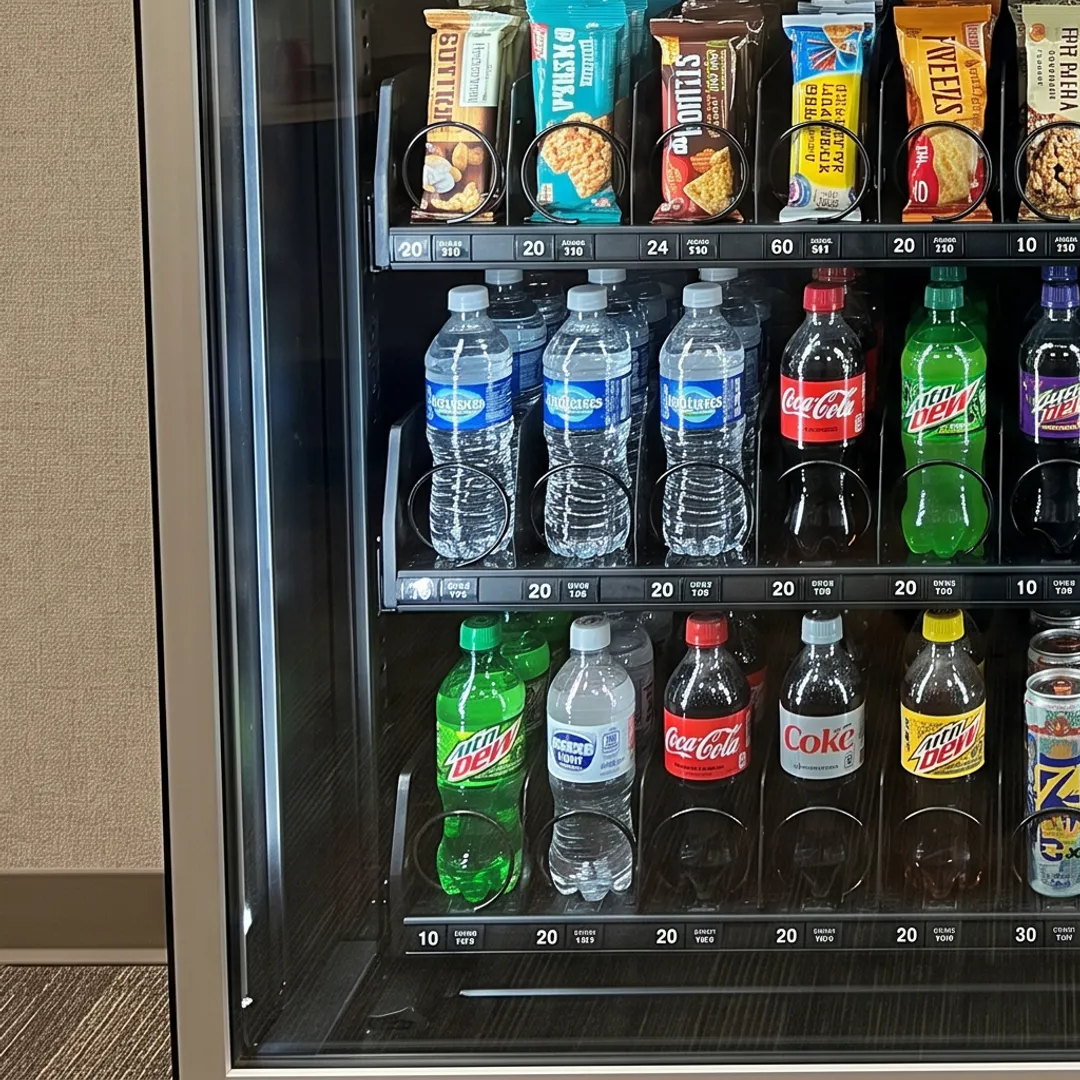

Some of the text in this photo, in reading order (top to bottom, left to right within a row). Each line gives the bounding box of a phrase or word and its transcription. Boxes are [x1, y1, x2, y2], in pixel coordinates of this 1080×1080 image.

[400, 241, 422, 257] 20
[522, 240, 545, 256] 20
[646, 239, 669, 256] 24
[770, 238, 794, 255] 60
[893, 237, 916, 253] 20
[1016, 236, 1038, 253] 10
[528, 582, 552, 599] 20
[651, 582, 674, 598] 20
[771, 581, 795, 597] 20
[894, 580, 917, 597] 20
[1016, 579, 1038, 595] 10
[665, 723, 743, 761] Coca-Cola
[784, 724, 856, 755] Coke
[417, 930, 439, 946] 10
[535, 929, 559, 945] 20
[655, 928, 678, 944] 20
[775, 927, 798, 944] 20
[896, 926, 918, 943] 20
[1015, 926, 1037, 942] 30
